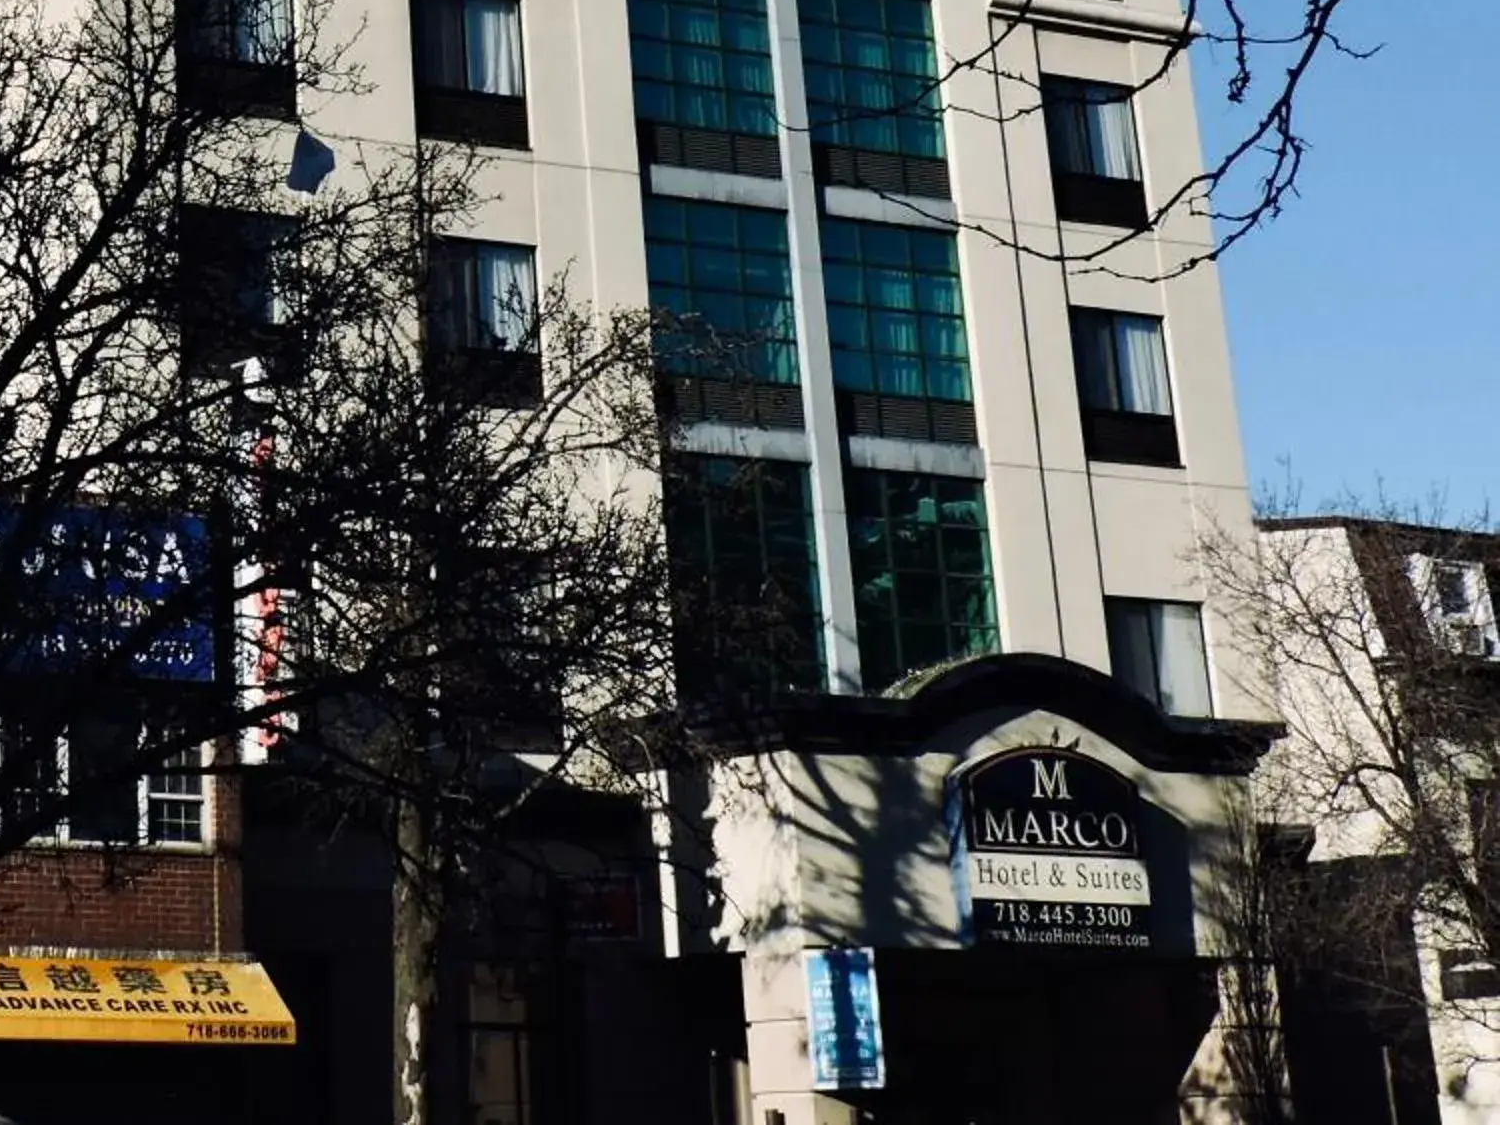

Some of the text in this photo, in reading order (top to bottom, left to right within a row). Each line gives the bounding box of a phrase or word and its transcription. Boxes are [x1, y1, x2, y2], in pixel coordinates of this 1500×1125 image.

[1030, 759, 1073, 800] M
[984, 808, 1128, 848] MARCO
[976, 858, 1144, 891] Hotel & Suites
[993, 903, 1132, 927] 718.445.3300
[107, 998, 169, 1014] CARE
[172, 1000, 204, 1014] RX
[208, 1001, 249, 1015] INC
